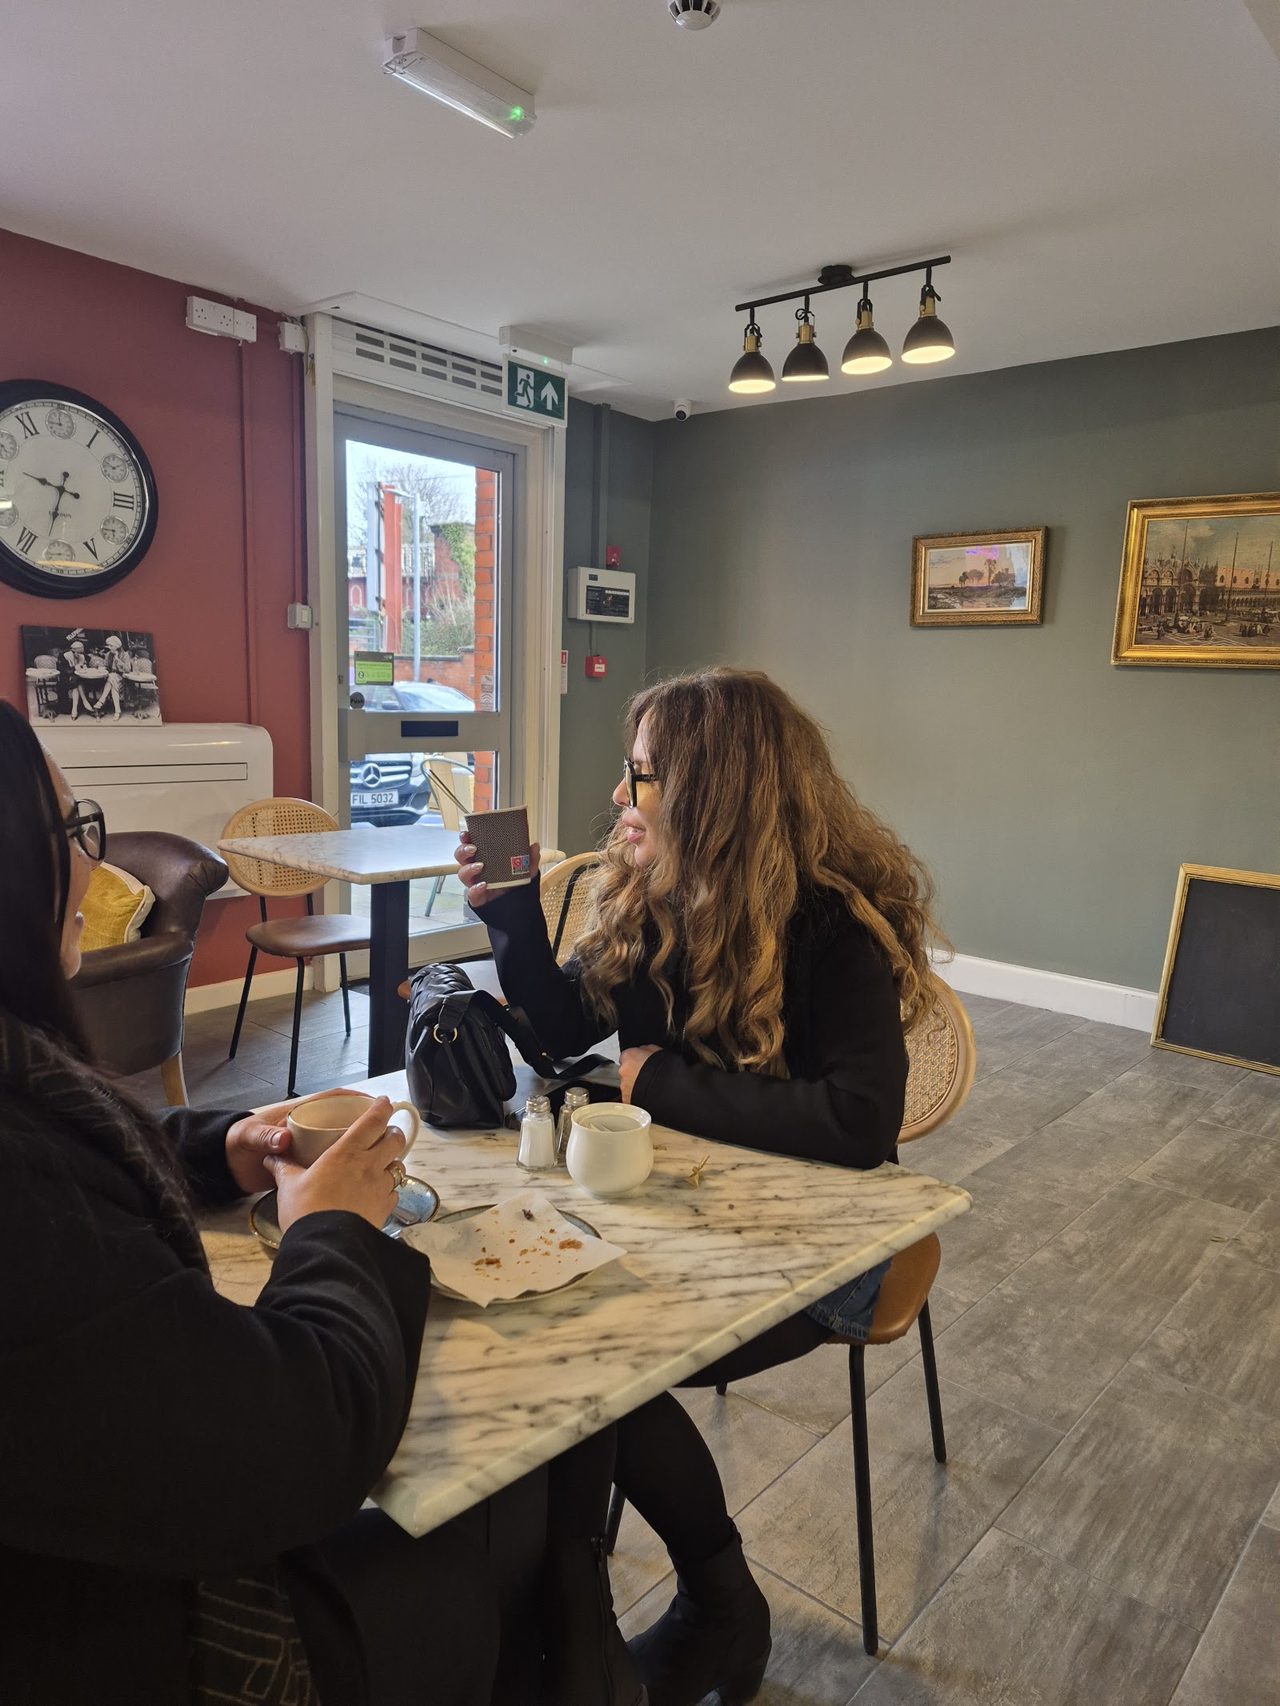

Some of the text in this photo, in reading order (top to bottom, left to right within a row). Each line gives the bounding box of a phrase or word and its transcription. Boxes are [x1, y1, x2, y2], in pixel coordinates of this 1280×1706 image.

[15, 411, 40, 439] XI
[86, 429, 101, 448] I
[113, 491, 134, 511] III
[16, 526, 39, 555] VII
[83, 537, 99, 561] V
[352, 793, 393, 804] FIL 5032
